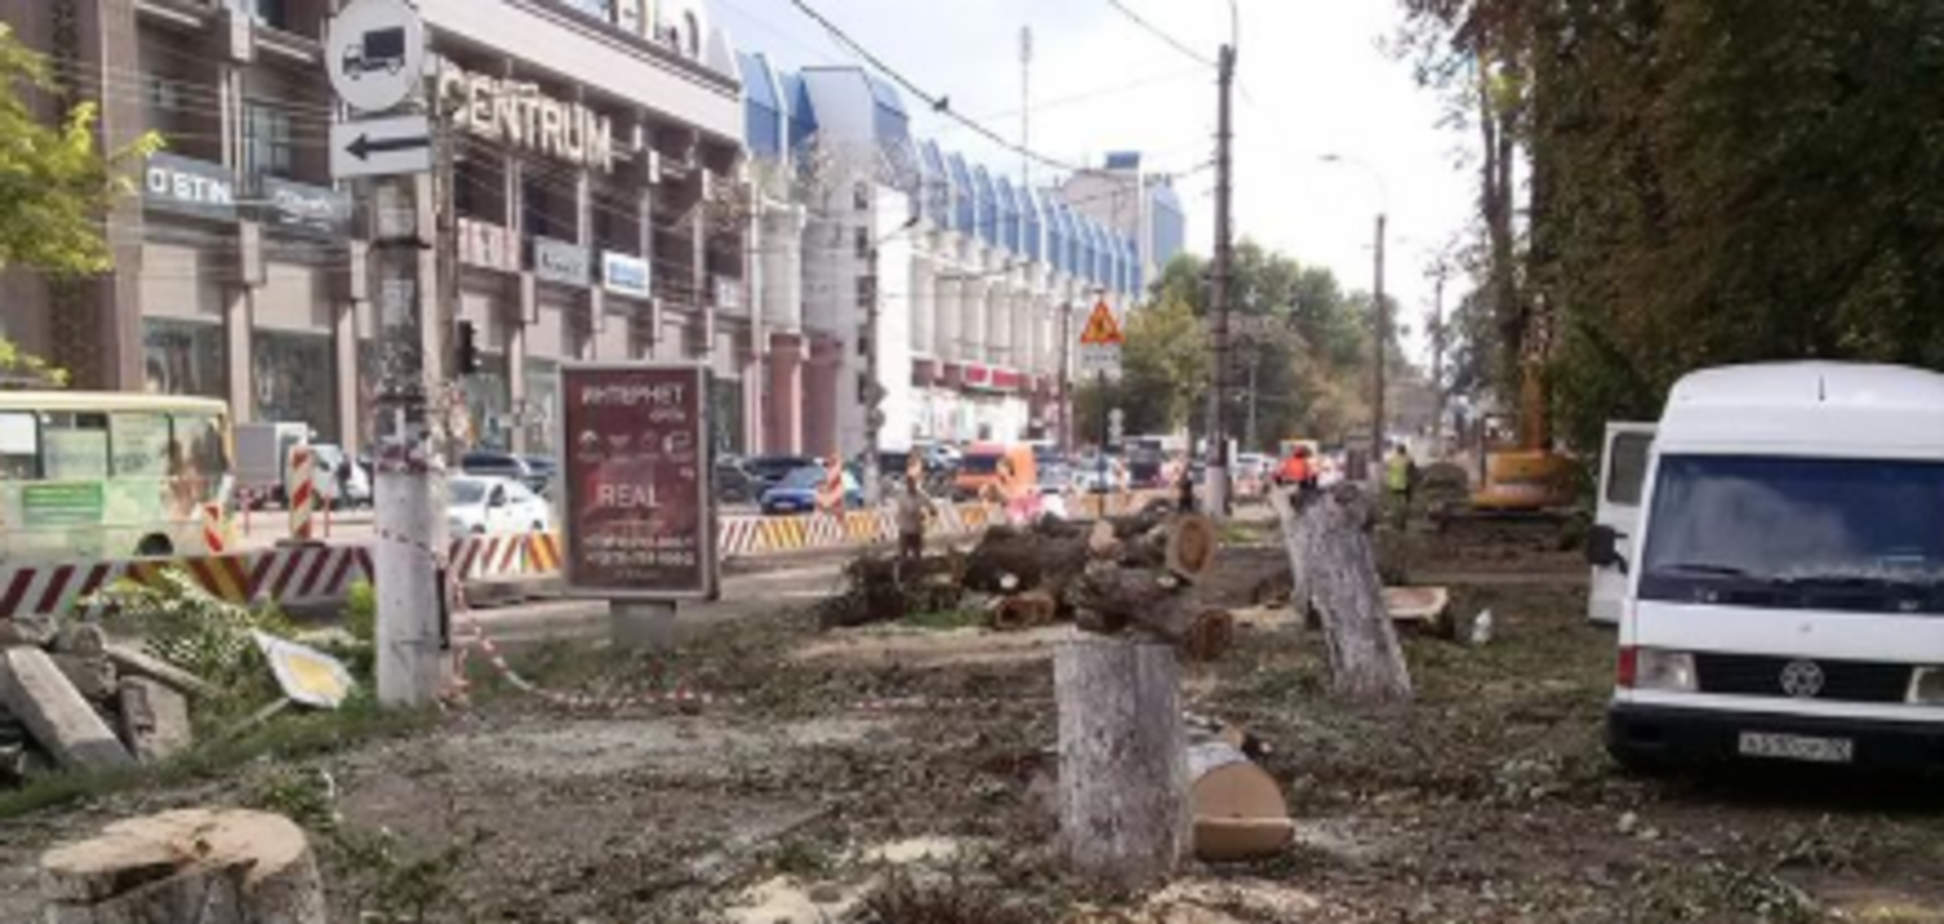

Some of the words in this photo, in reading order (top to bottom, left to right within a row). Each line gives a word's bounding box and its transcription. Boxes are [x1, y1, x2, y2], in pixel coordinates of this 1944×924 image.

[438, 56, 613, 173] CENTRUM
[581, 382, 685, 406] ИНТЕРНЕТ
[597, 483, 662, 509] REAL
